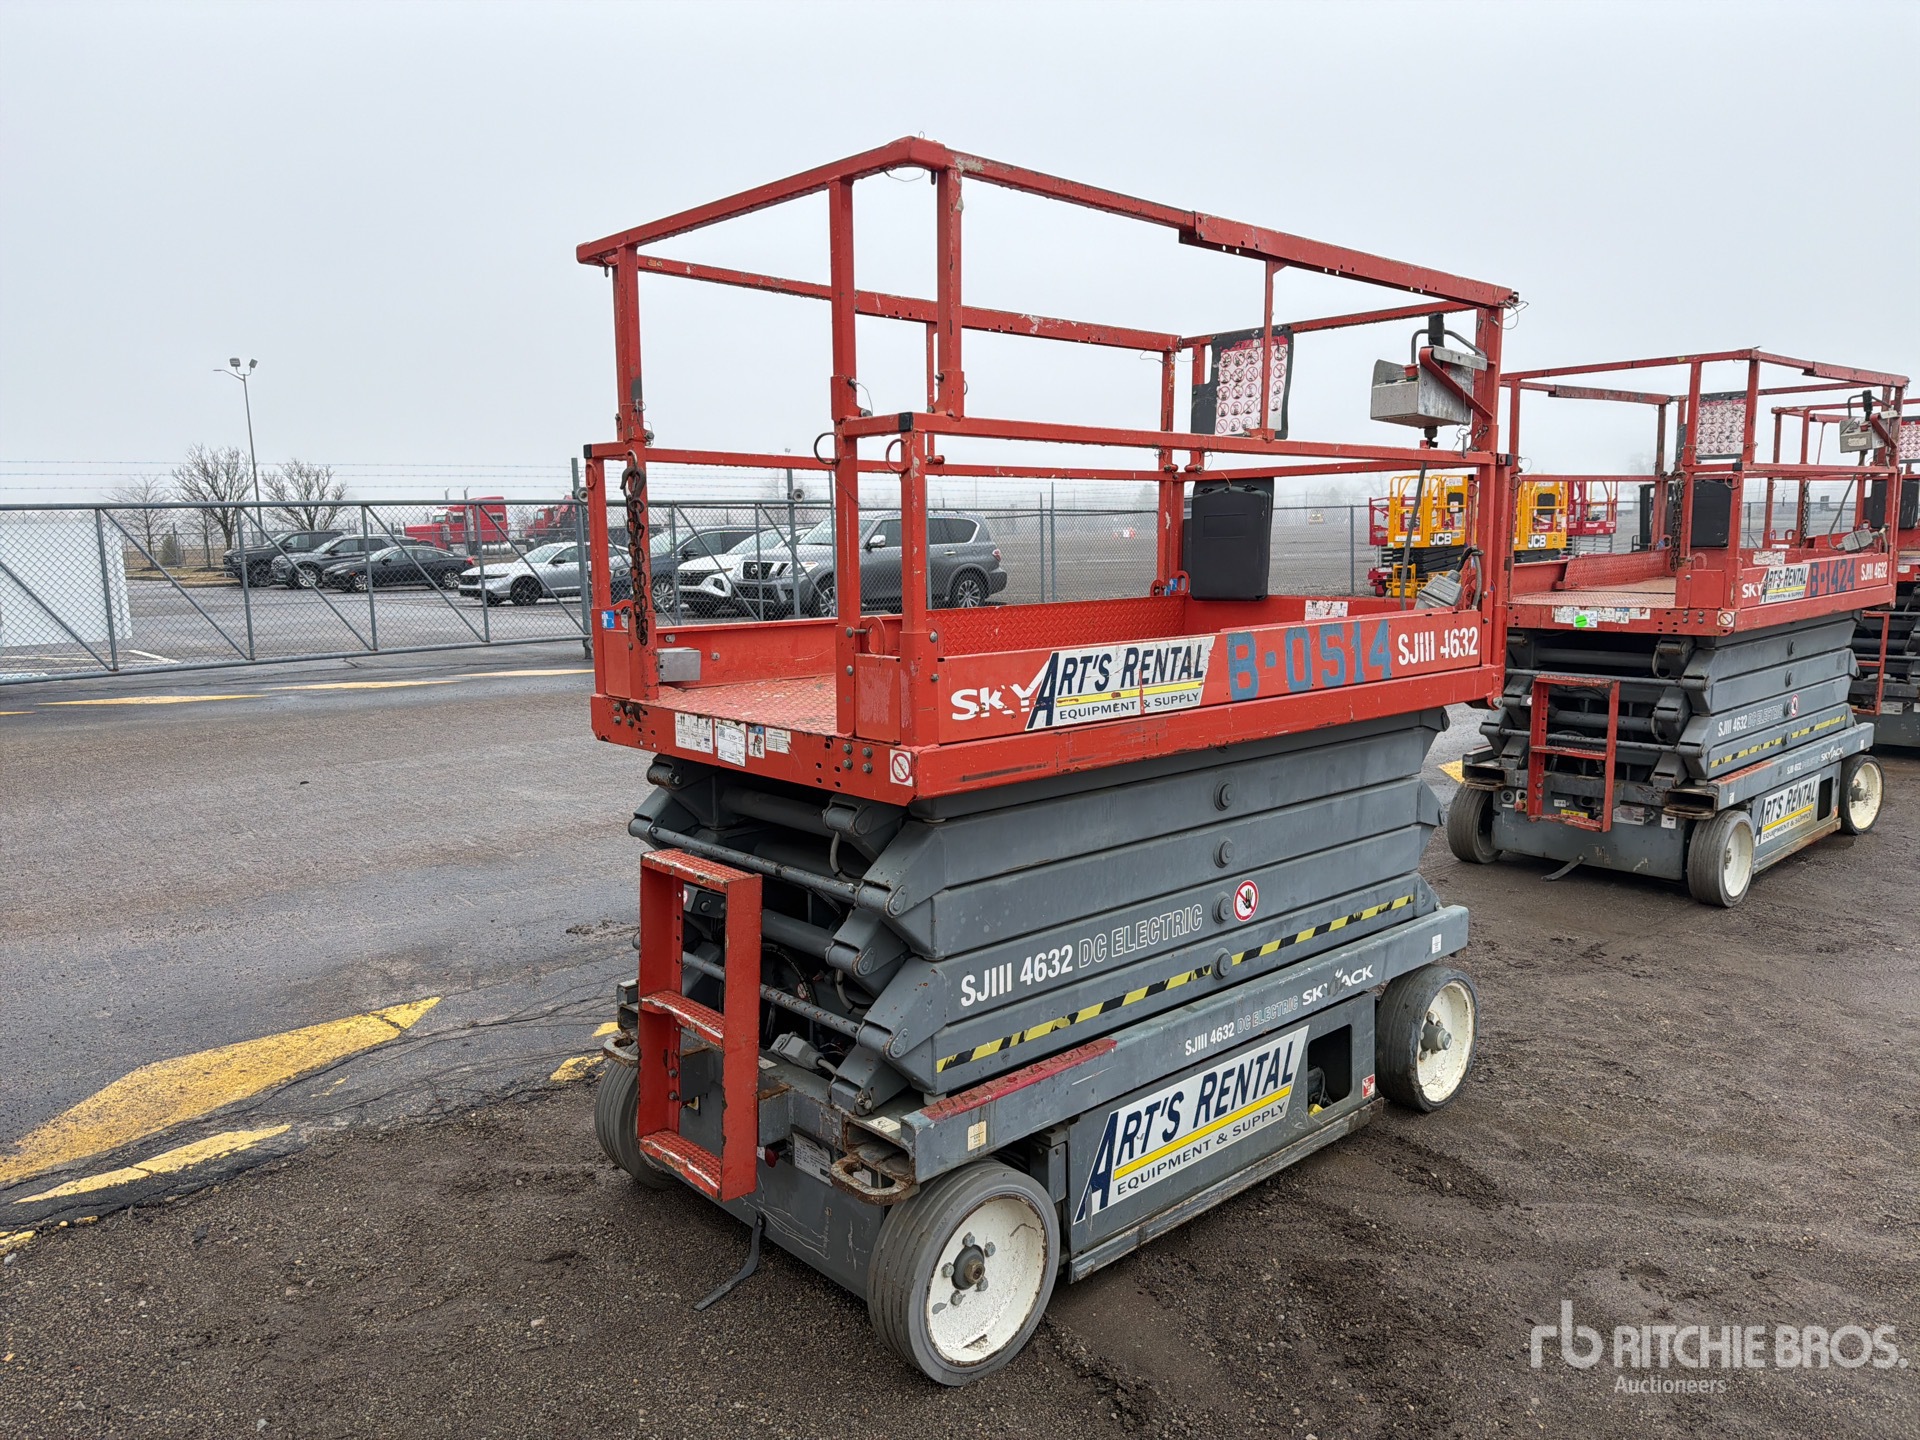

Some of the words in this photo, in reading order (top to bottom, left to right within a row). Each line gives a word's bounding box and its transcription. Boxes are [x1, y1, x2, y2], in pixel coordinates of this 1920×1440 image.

[1430, 533, 1452, 546] JCB
[1528, 534, 1546, 549] JCB
[1742, 583, 1762, 599] SKY
[1783, 567, 1807, 587] RENTAL
[1440, 626, 1478, 659] 4632
[1027, 646, 1112, 729] ART'S
[1120, 643, 1204, 688] RENTAL
[1059, 700, 1137, 720] EQUIPMENT
[1143, 699, 1151, 708] &
[1154, 692, 1199, 707] SUPPLY
[1732, 714, 1748, 732] 4632
[1755, 795, 1784, 845] ART'S
[1784, 780, 1816, 815] RENTAL
[1762, 824, 1791, 841] EQUIPMENT
[961, 963, 1013, 1007] SJIII
[1019, 944, 1073, 987] 4632
[1078, 936, 1107, 969] DC
[1111, 903, 1203, 958] ELECTRIC
[1185, 1032, 1208, 1056] SJIII
[1210, 1022, 1235, 1044] 4632
[1237, 1015, 1252, 1033] DC
[1252, 995, 1299, 1027] ELECTRIC
[1302, 964, 1374, 1006] SKACK
[1075, 1091, 1184, 1223] ART'S
[1193, 1041, 1297, 1128] RENTAL
[1117, 1139, 1211, 1196] EQUIPMENT
[1216, 1133, 1228, 1145] &
[1232, 1101, 1287, 1137] SUPPLY
